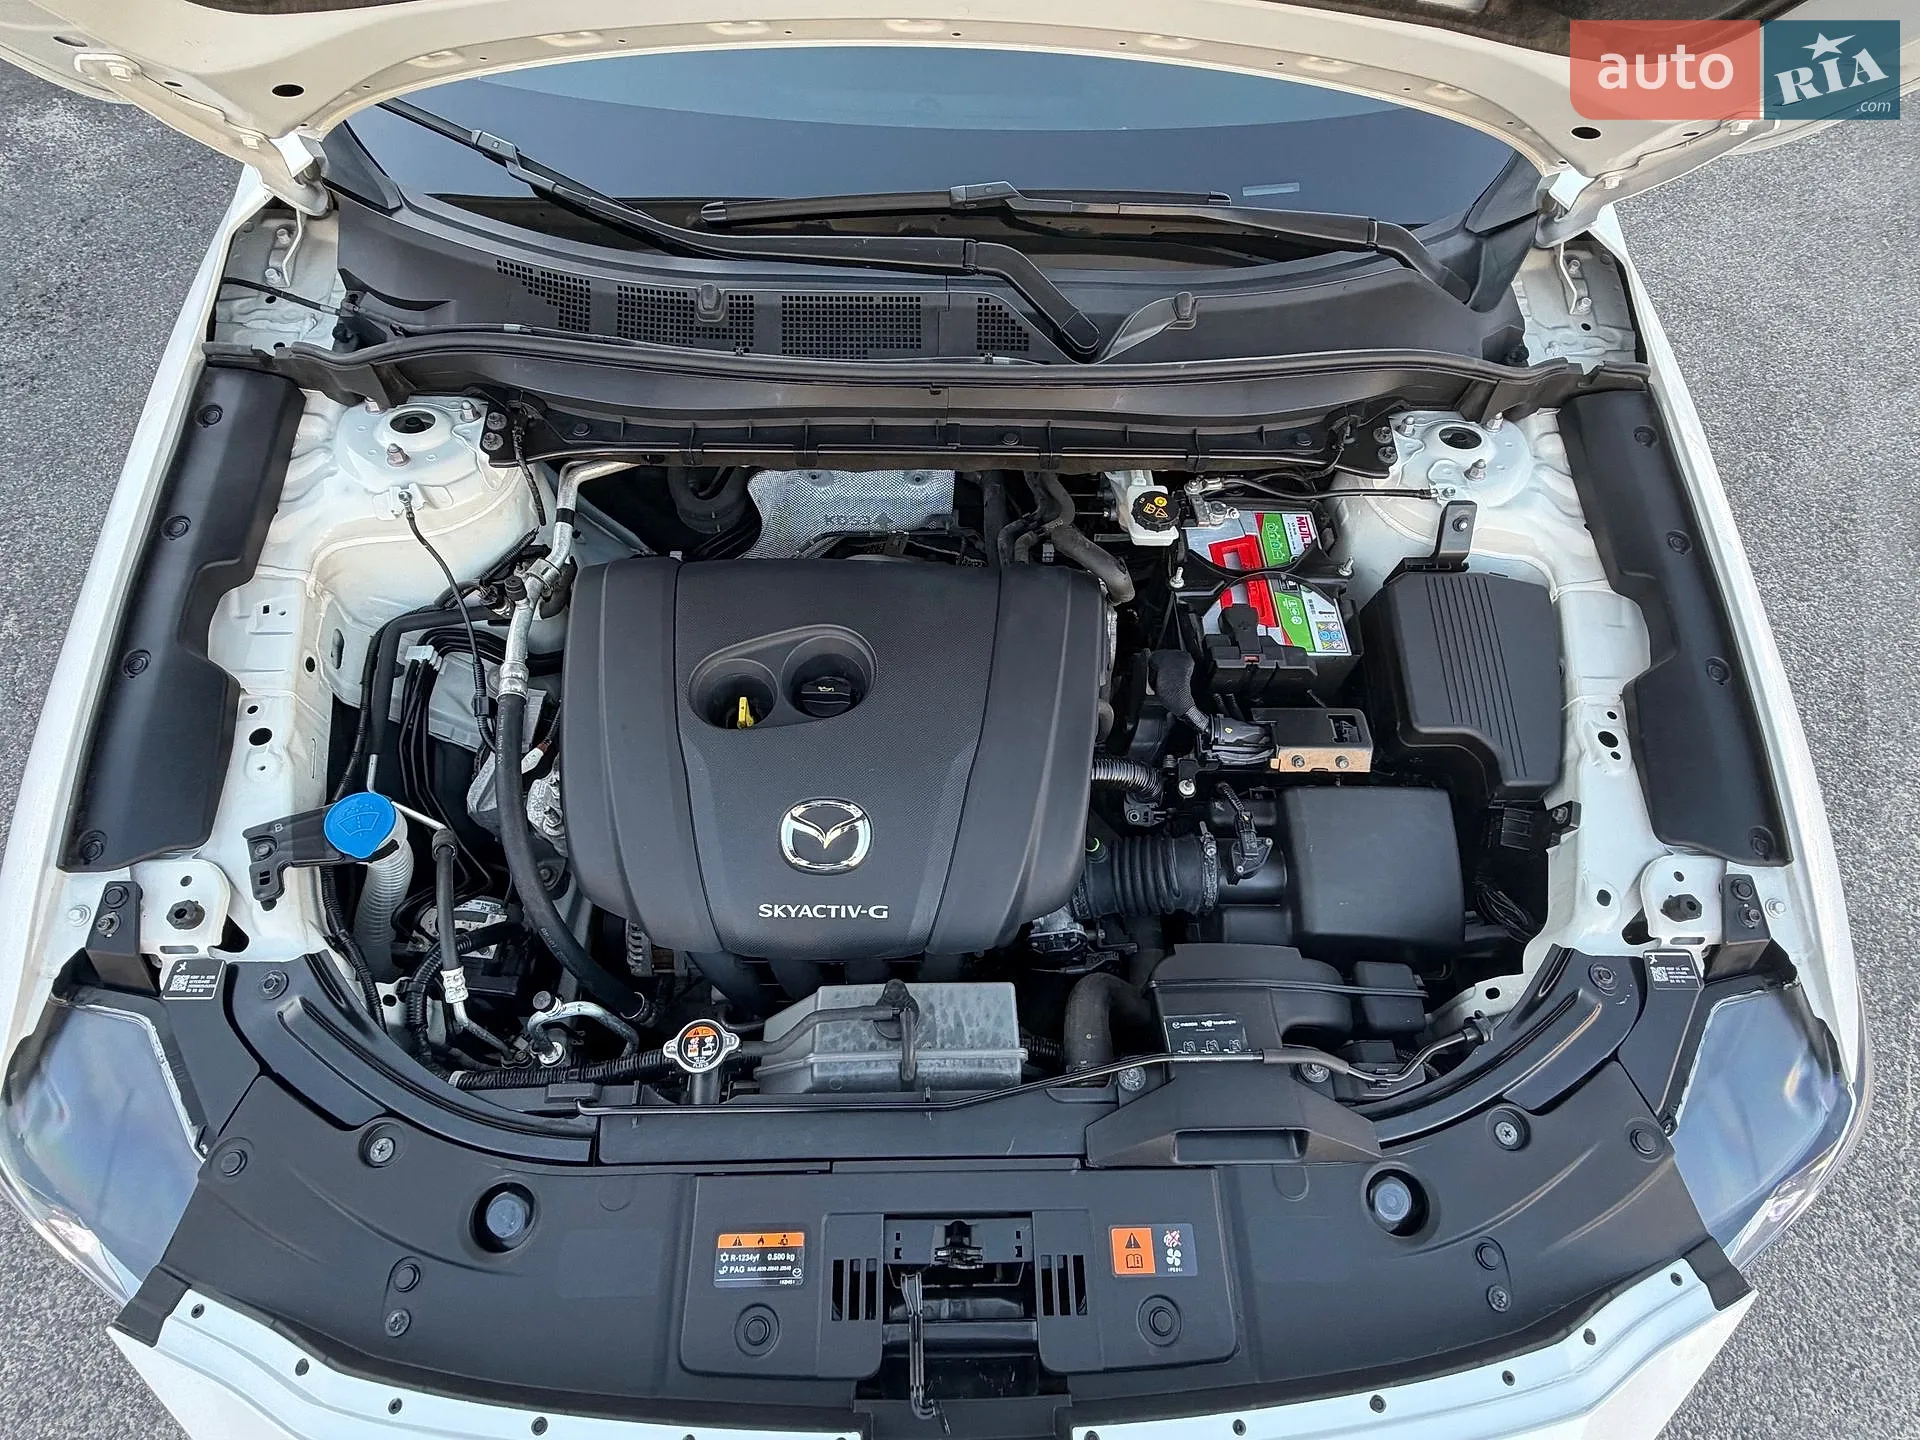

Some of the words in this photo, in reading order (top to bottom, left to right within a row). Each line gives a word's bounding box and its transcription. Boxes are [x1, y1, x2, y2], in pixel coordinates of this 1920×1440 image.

[758, 903, 889, 919] SKYACTIV-G
[730, 1253, 760, 1263] R-1234yf
[767, 1253, 785, 1261] 0.500
[786, 1253, 796, 1262] kg
[729, 1265, 745, 1274] PAG
